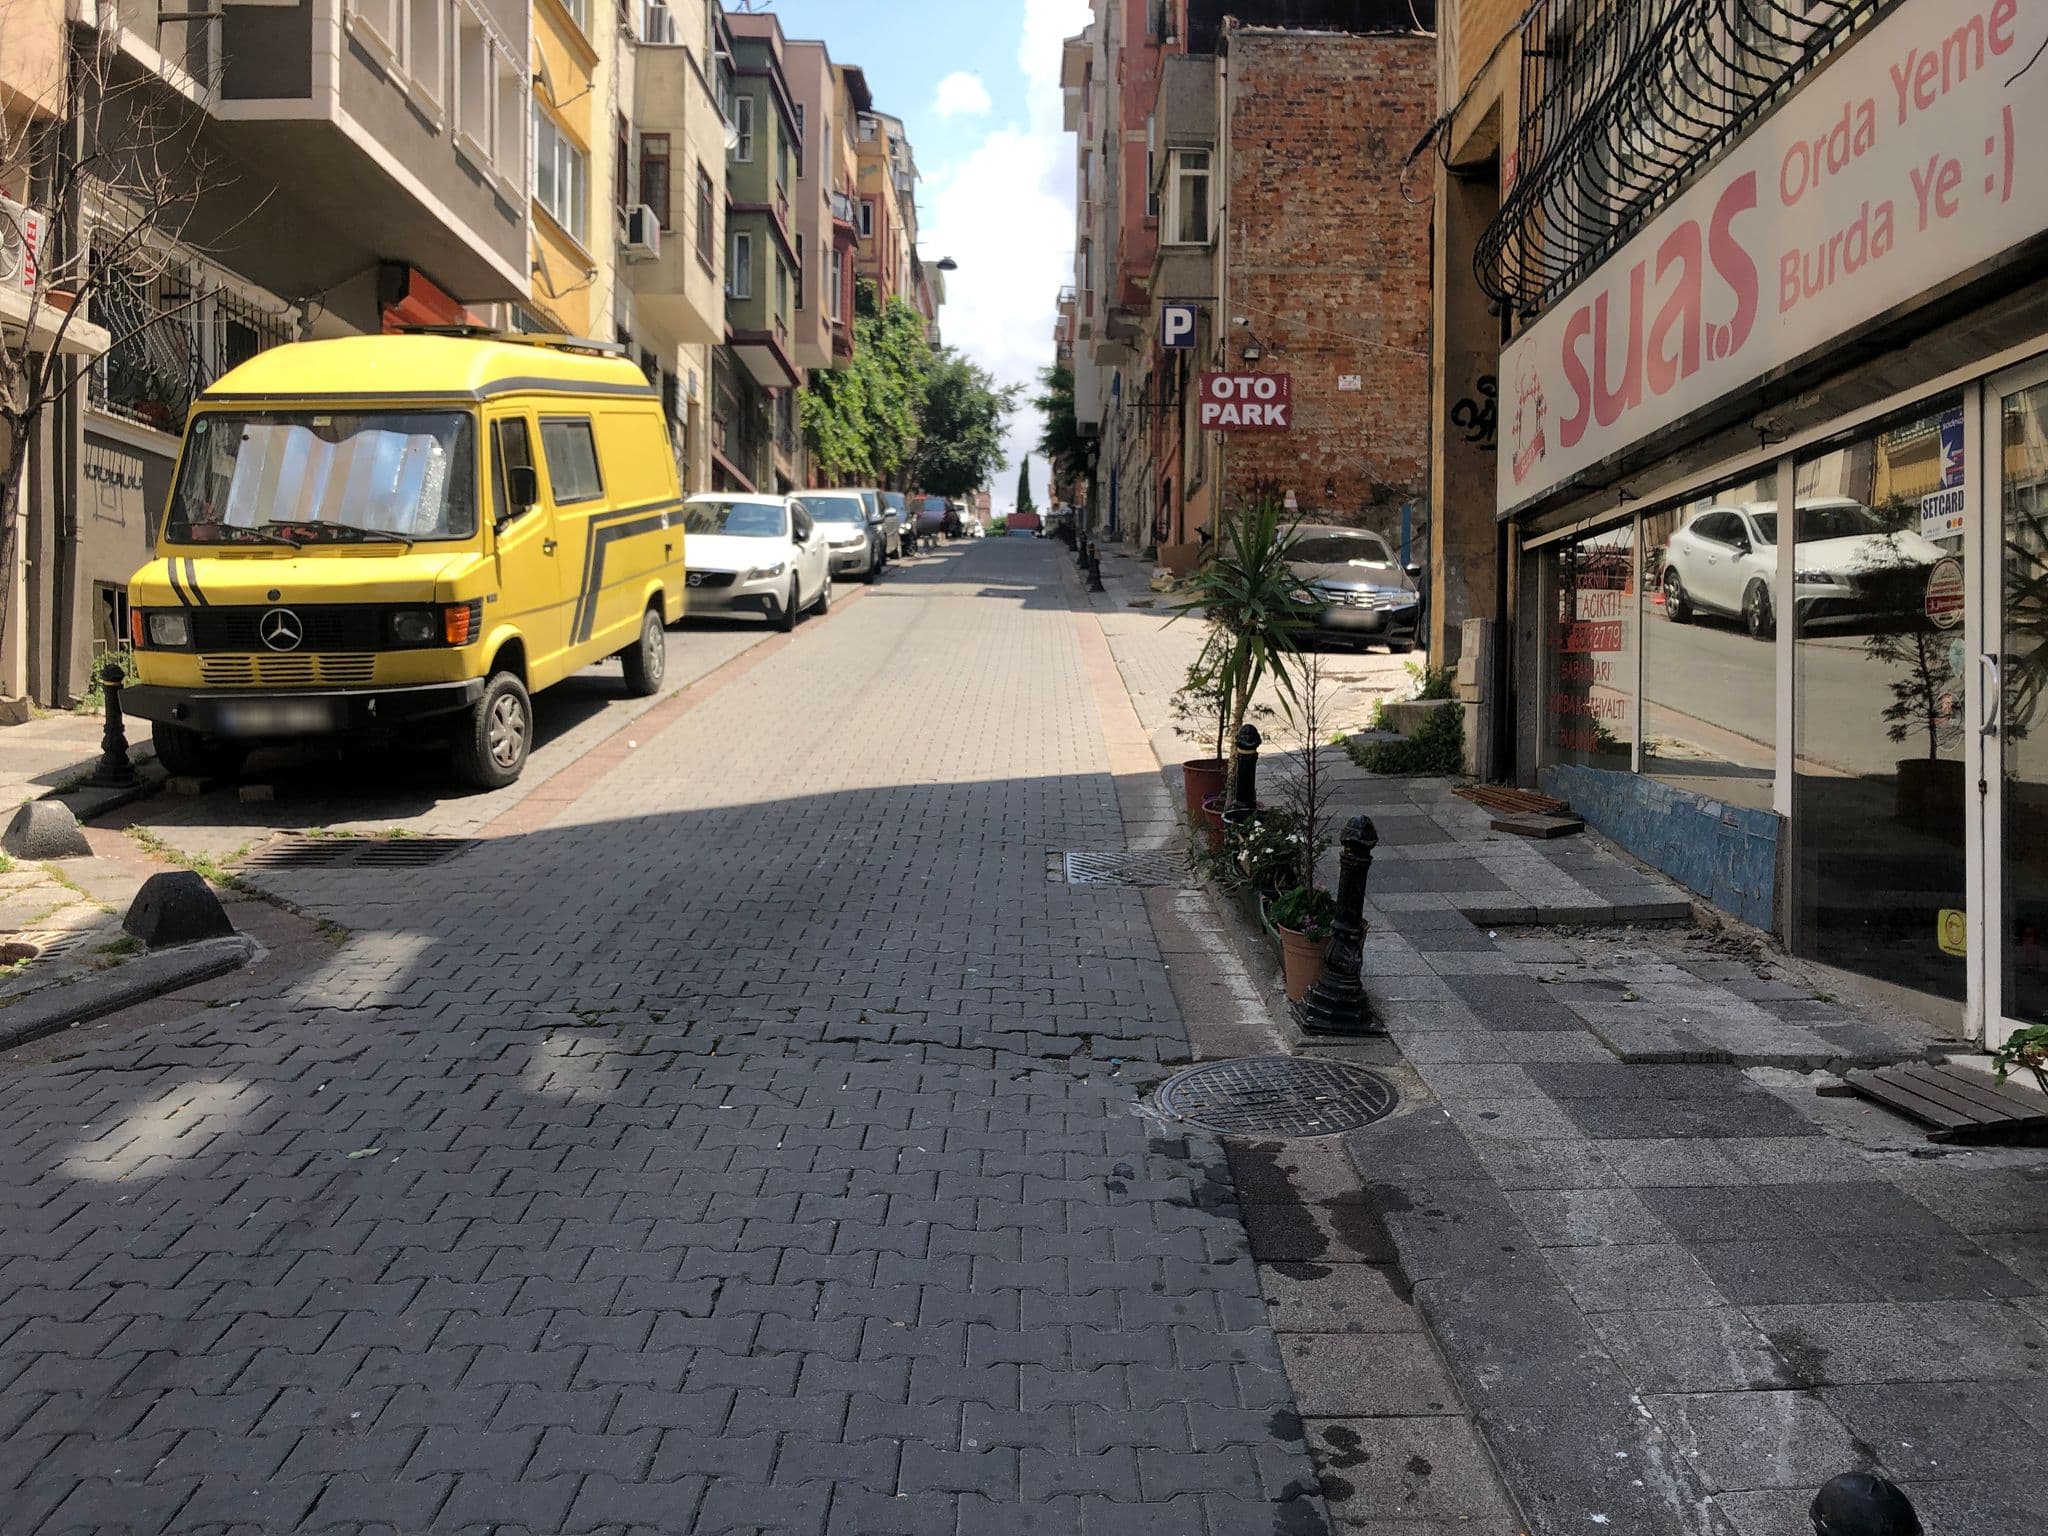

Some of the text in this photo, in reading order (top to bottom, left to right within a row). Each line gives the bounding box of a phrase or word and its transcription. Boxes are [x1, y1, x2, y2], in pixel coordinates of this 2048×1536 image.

[1779, 0, 2018, 207] Orda Yeme
[1779, 200, 1895, 314] Burda
[1909, 152, 1963, 232] Ye
[1165, 307, 1193, 345] P
[1211, 377, 1277, 399] OTO
[1201, 403, 1287, 426] PARK
[1922, 489, 1965, 520] SETCARD
